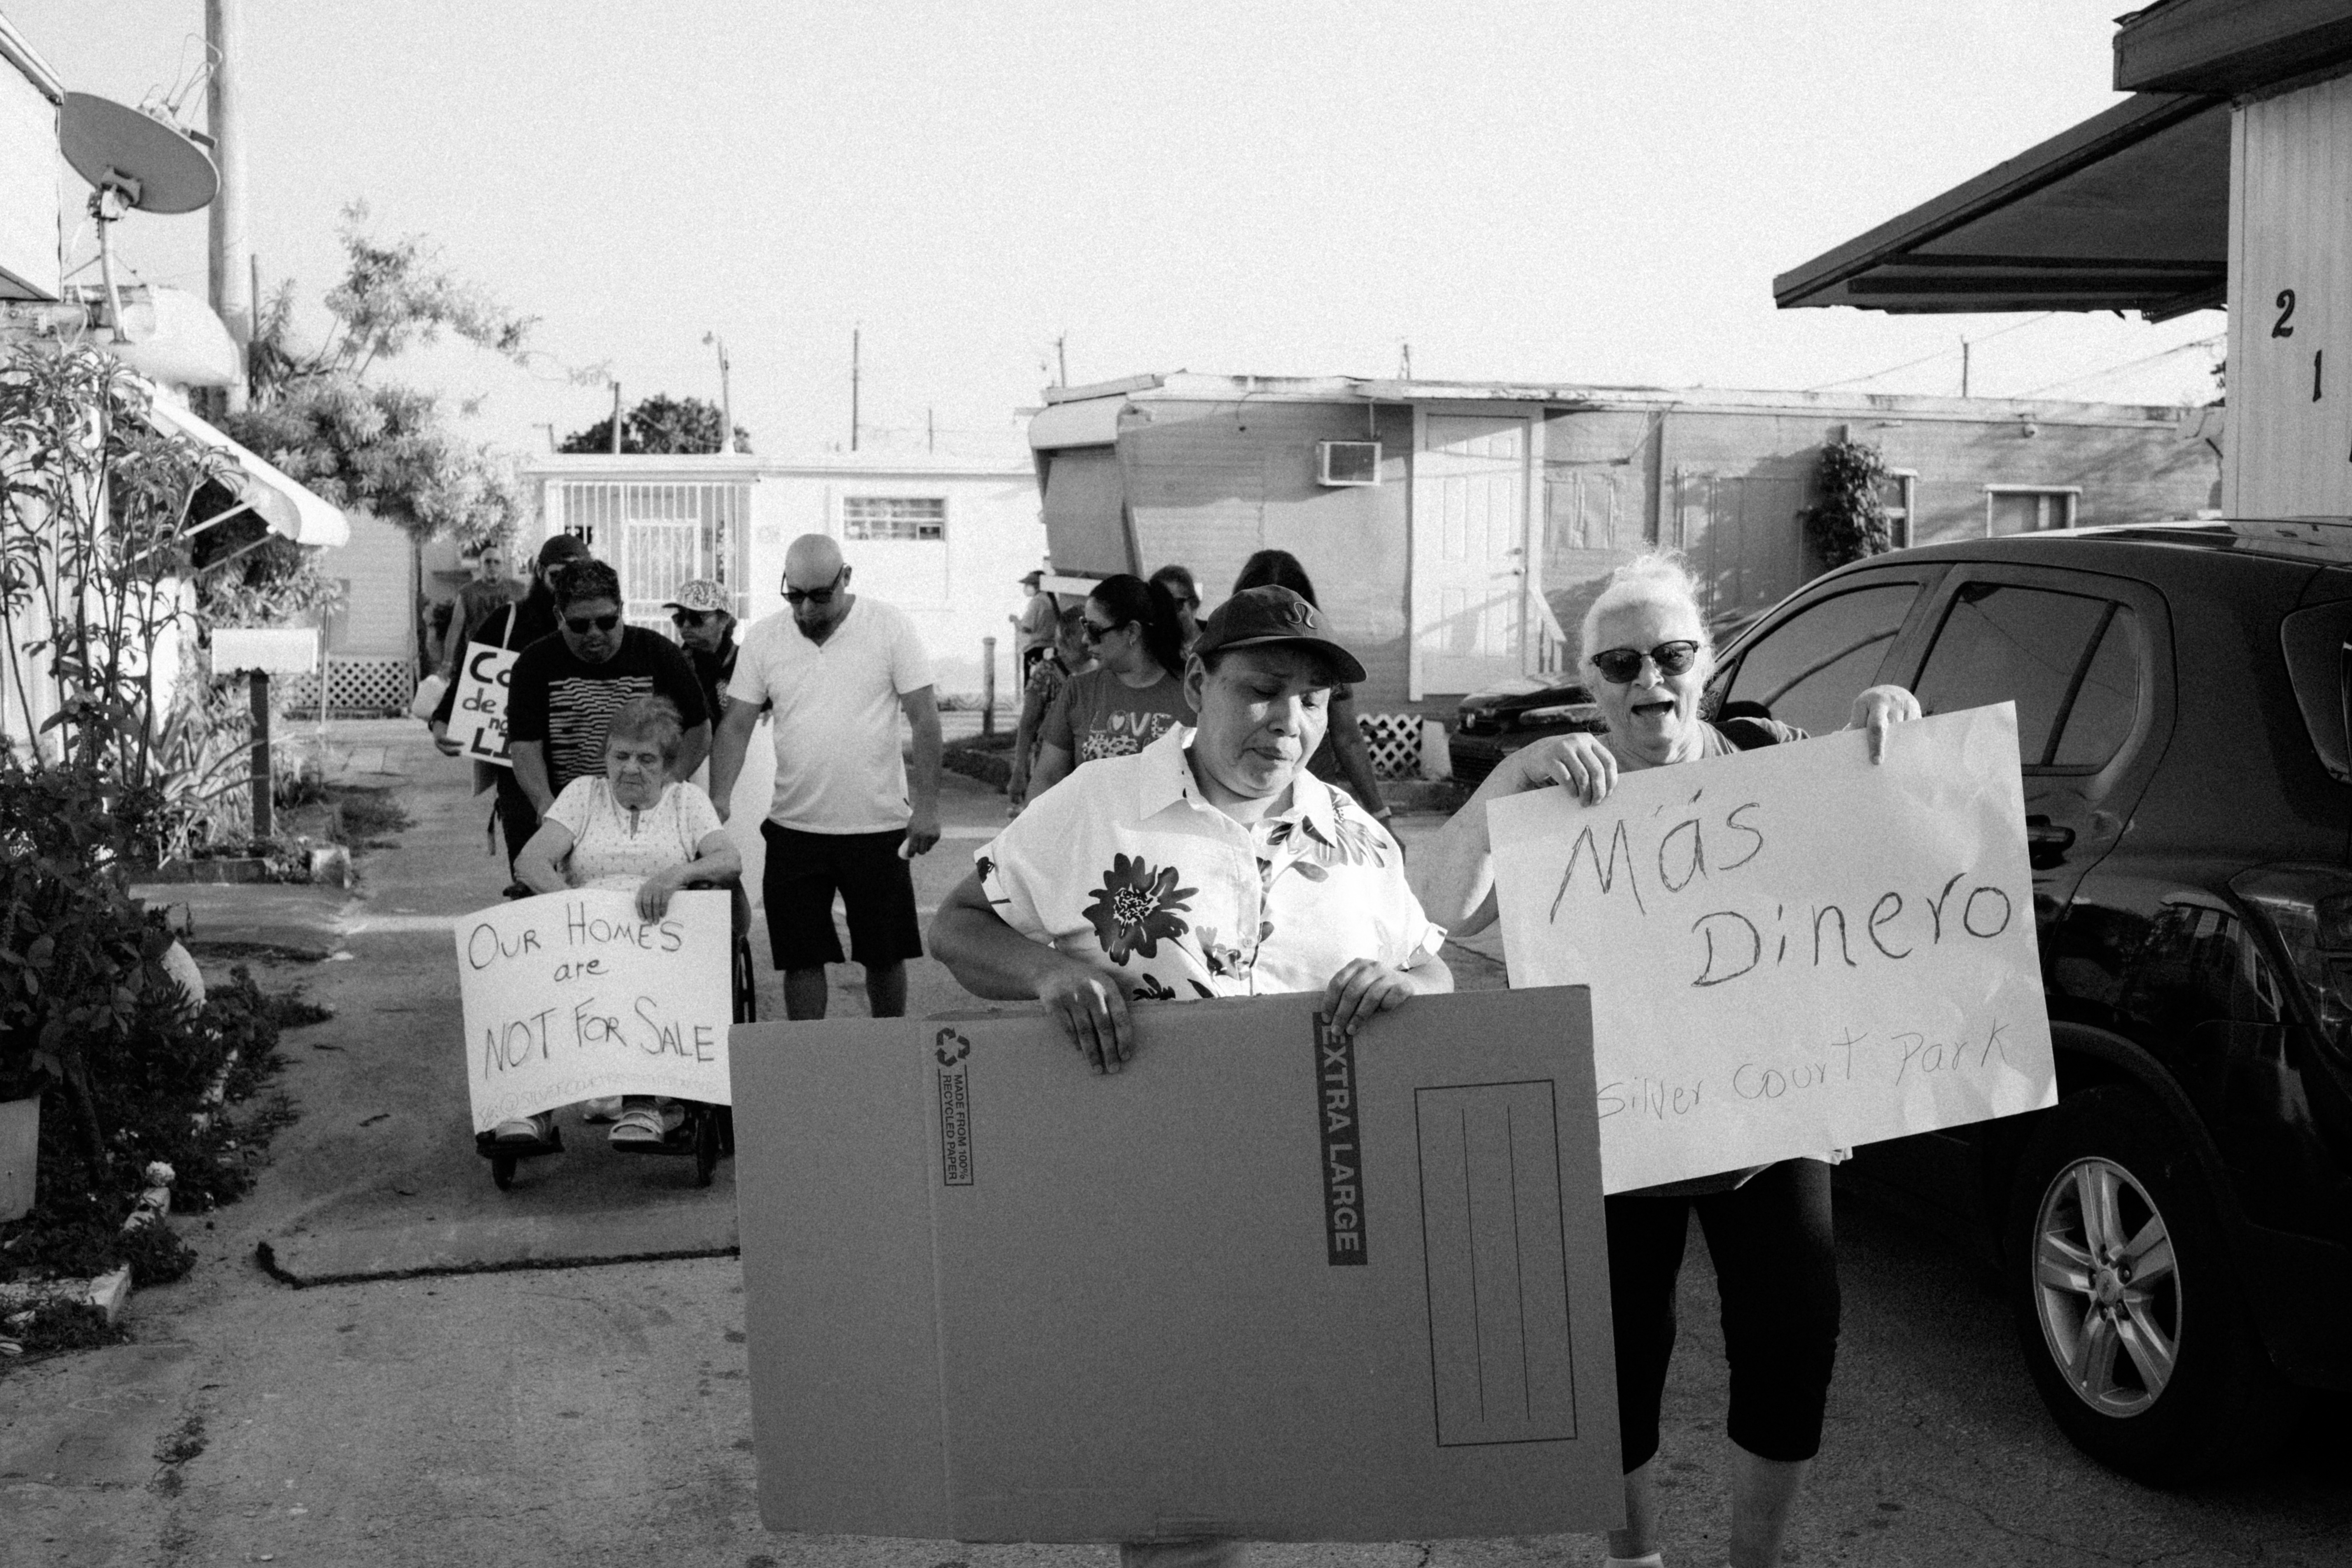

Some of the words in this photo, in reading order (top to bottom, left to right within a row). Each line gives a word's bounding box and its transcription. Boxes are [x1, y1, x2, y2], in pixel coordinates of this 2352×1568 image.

[462, 687, 497, 714] de
[1089, 710, 1172, 738] LOVE
[567, 901, 684, 952] HOMES
[1690, 872, 2011, 988] Dinero
[554, 959, 609, 982] are
[485, 1007, 557, 1080] NOT
[574, 998, 627, 1048] FOR
[634, 996, 714, 1063] SALE
[1322, 1025, 1351, 1134] EXTRA
[1733, 1027, 1868, 1100] Court
[943, 1075, 955, 1139] RECYCLED
[954, 1074, 964, 1108] MADE
[956, 1112, 967, 1146] FROM
[947, 1142, 957, 1180] PAPER
[959, 1150, 969, 1180] 100%
[1329, 1143, 1360, 1252] LARGE
